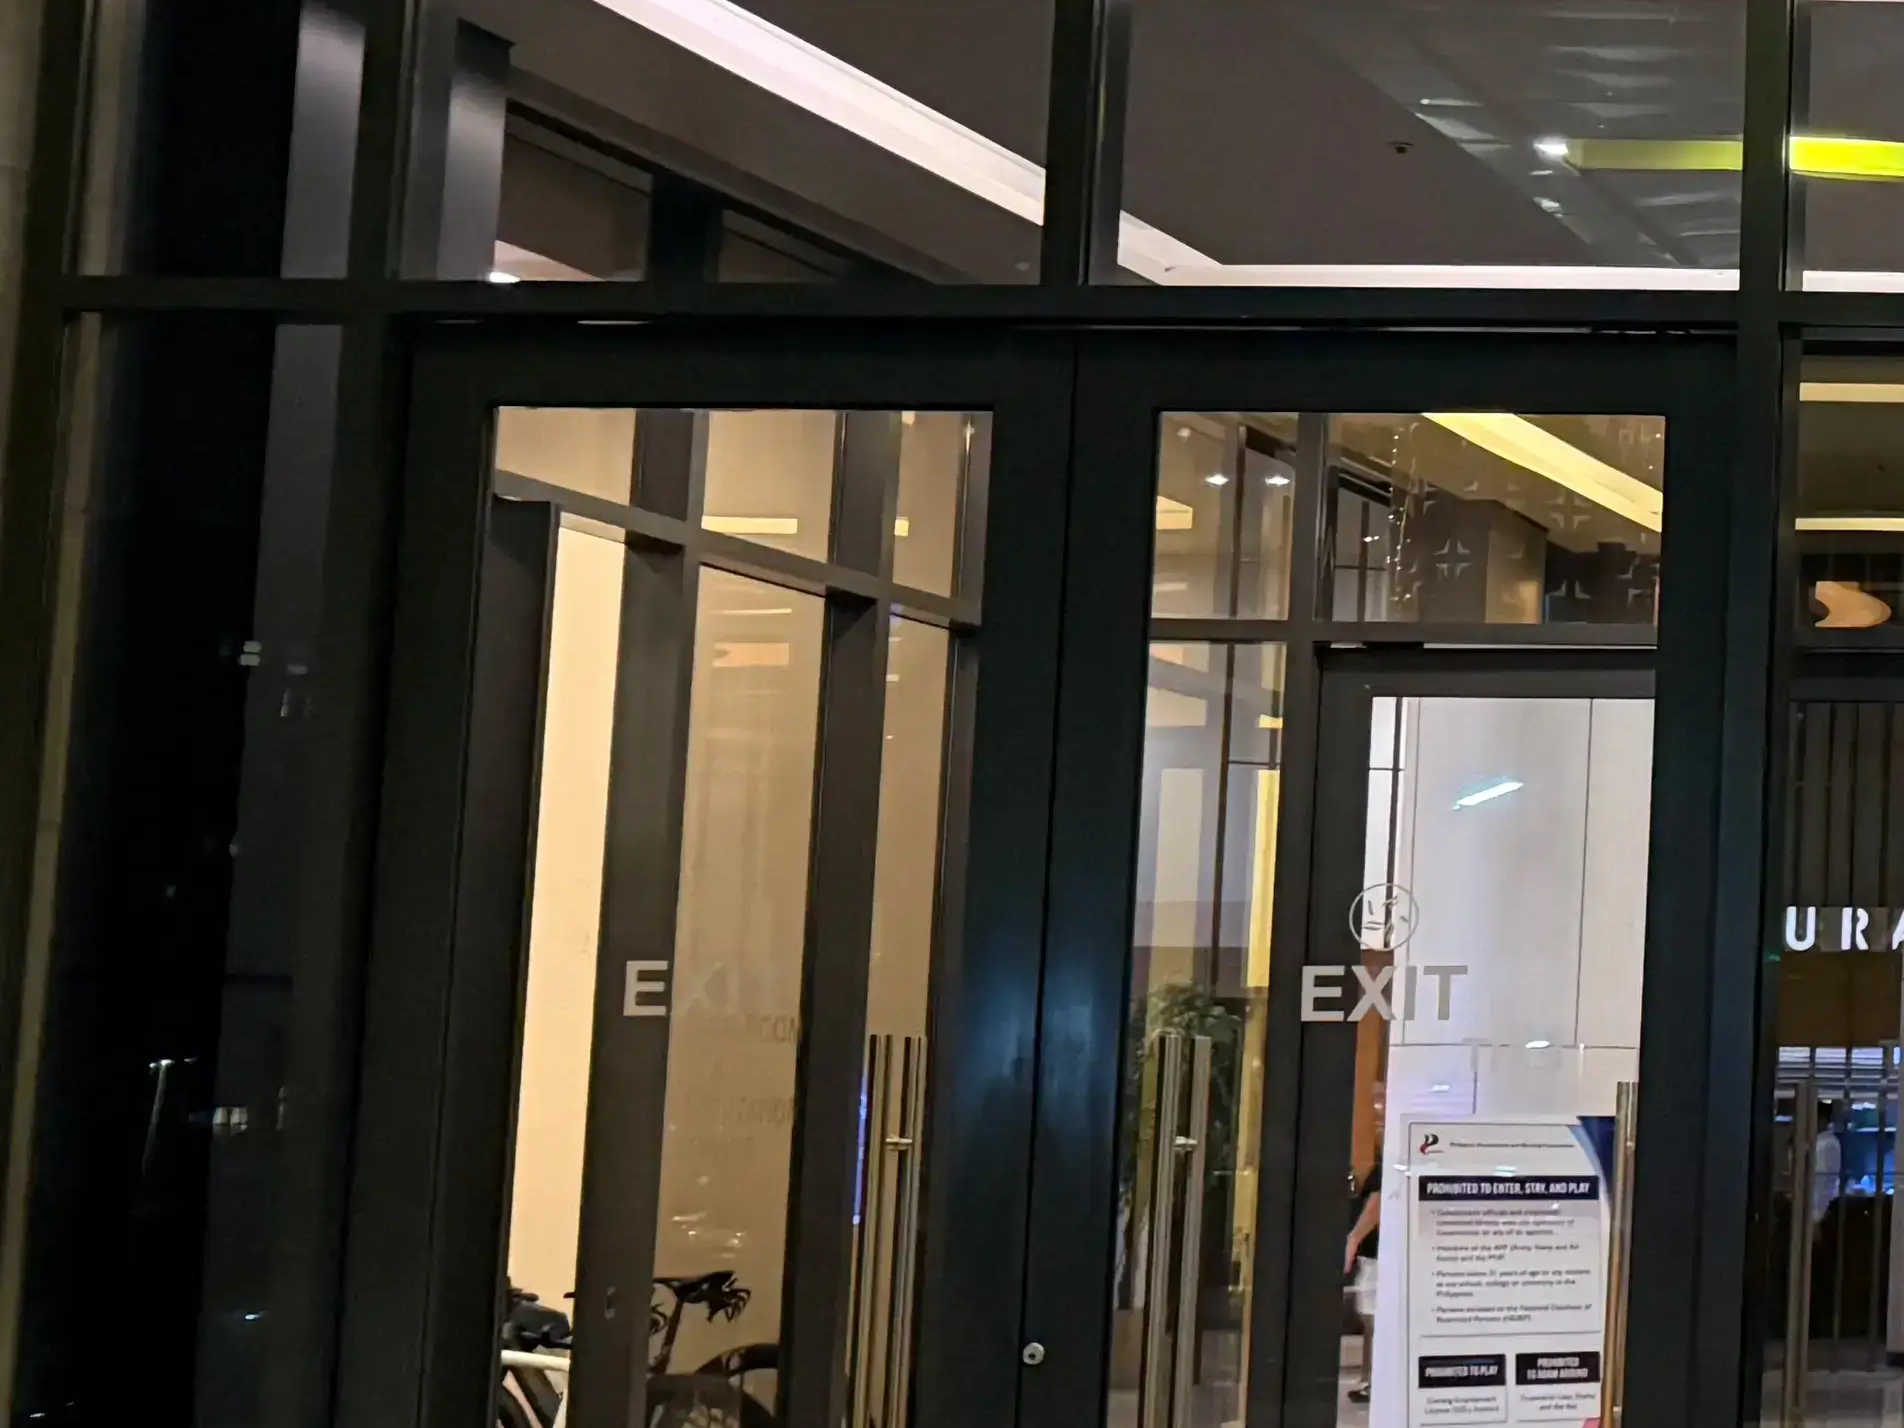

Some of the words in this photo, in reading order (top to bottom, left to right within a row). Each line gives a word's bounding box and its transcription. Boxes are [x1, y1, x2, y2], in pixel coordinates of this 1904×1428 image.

[1301, 965, 1468, 1021] EXIT
[1427, 1182, 1479, 1195] PROHIBITED
[1480, 1183, 1492, 1195] TO
[1568, 1183, 1590, 1194] PLAY
